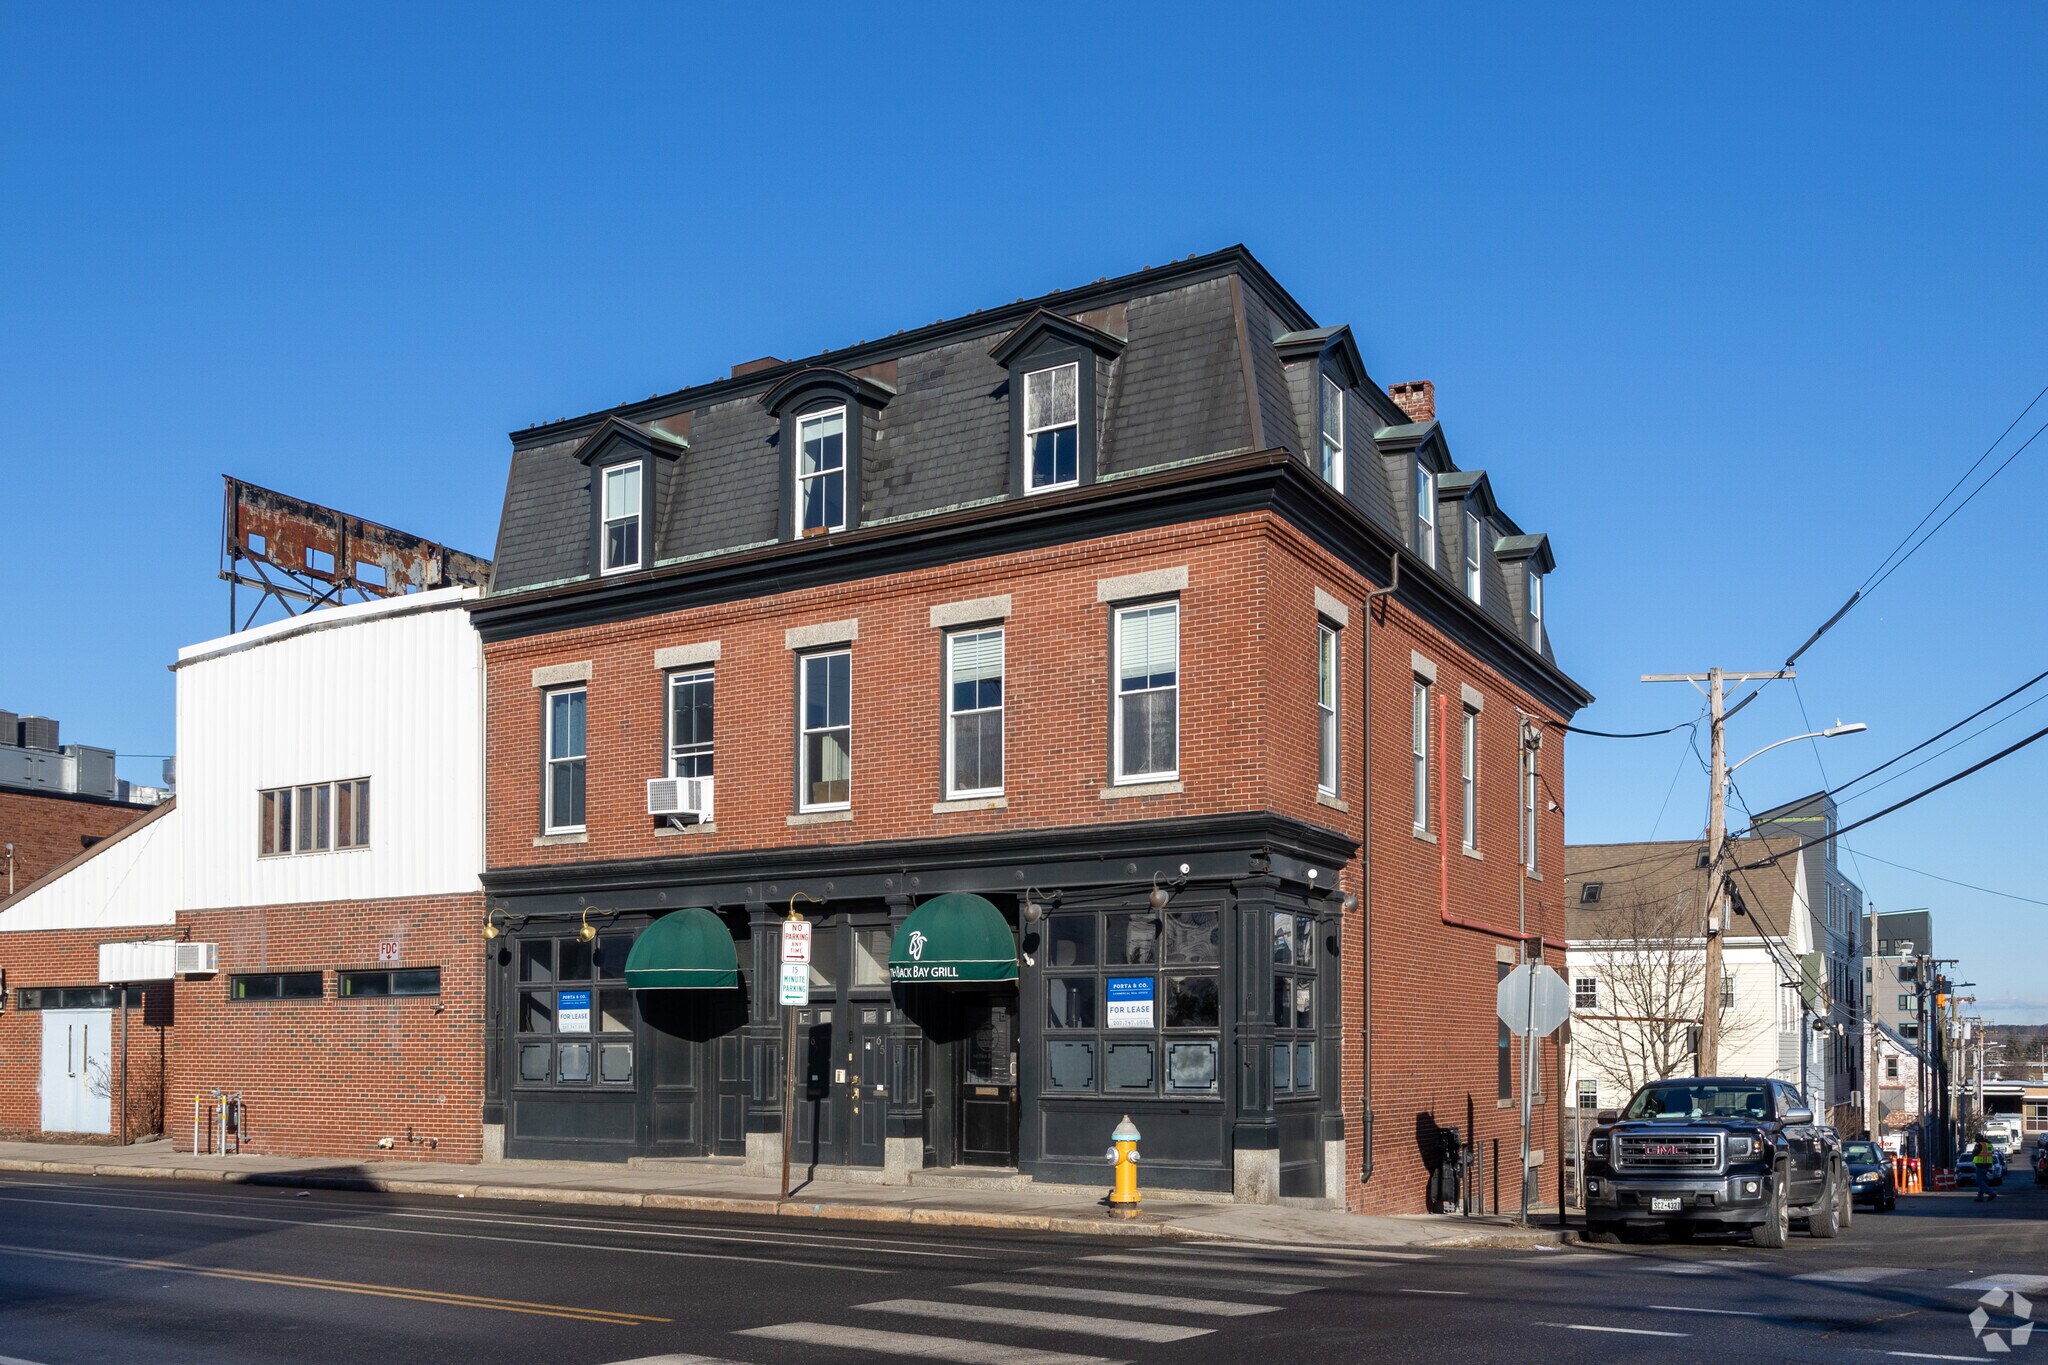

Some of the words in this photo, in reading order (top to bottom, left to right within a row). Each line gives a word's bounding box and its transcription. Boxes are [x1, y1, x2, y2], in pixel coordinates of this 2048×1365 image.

[791, 924, 803, 932] NO
[785, 932, 809, 941] PARKING
[381, 942, 397, 954] FDC
[792, 966, 798, 974] 15
[913, 965, 930, 978] BAY
[930, 966, 959, 977] GRILL
[784, 975, 805, 983] MINUTE
[782, 984, 806, 992] PARKING
[1109, 1006, 1125, 1014] FOR
[1126, 1005, 1150, 1013] LEASE
[571, 1012, 588, 1020] LEASE
[1645, 1145, 1688, 1155] GMC
